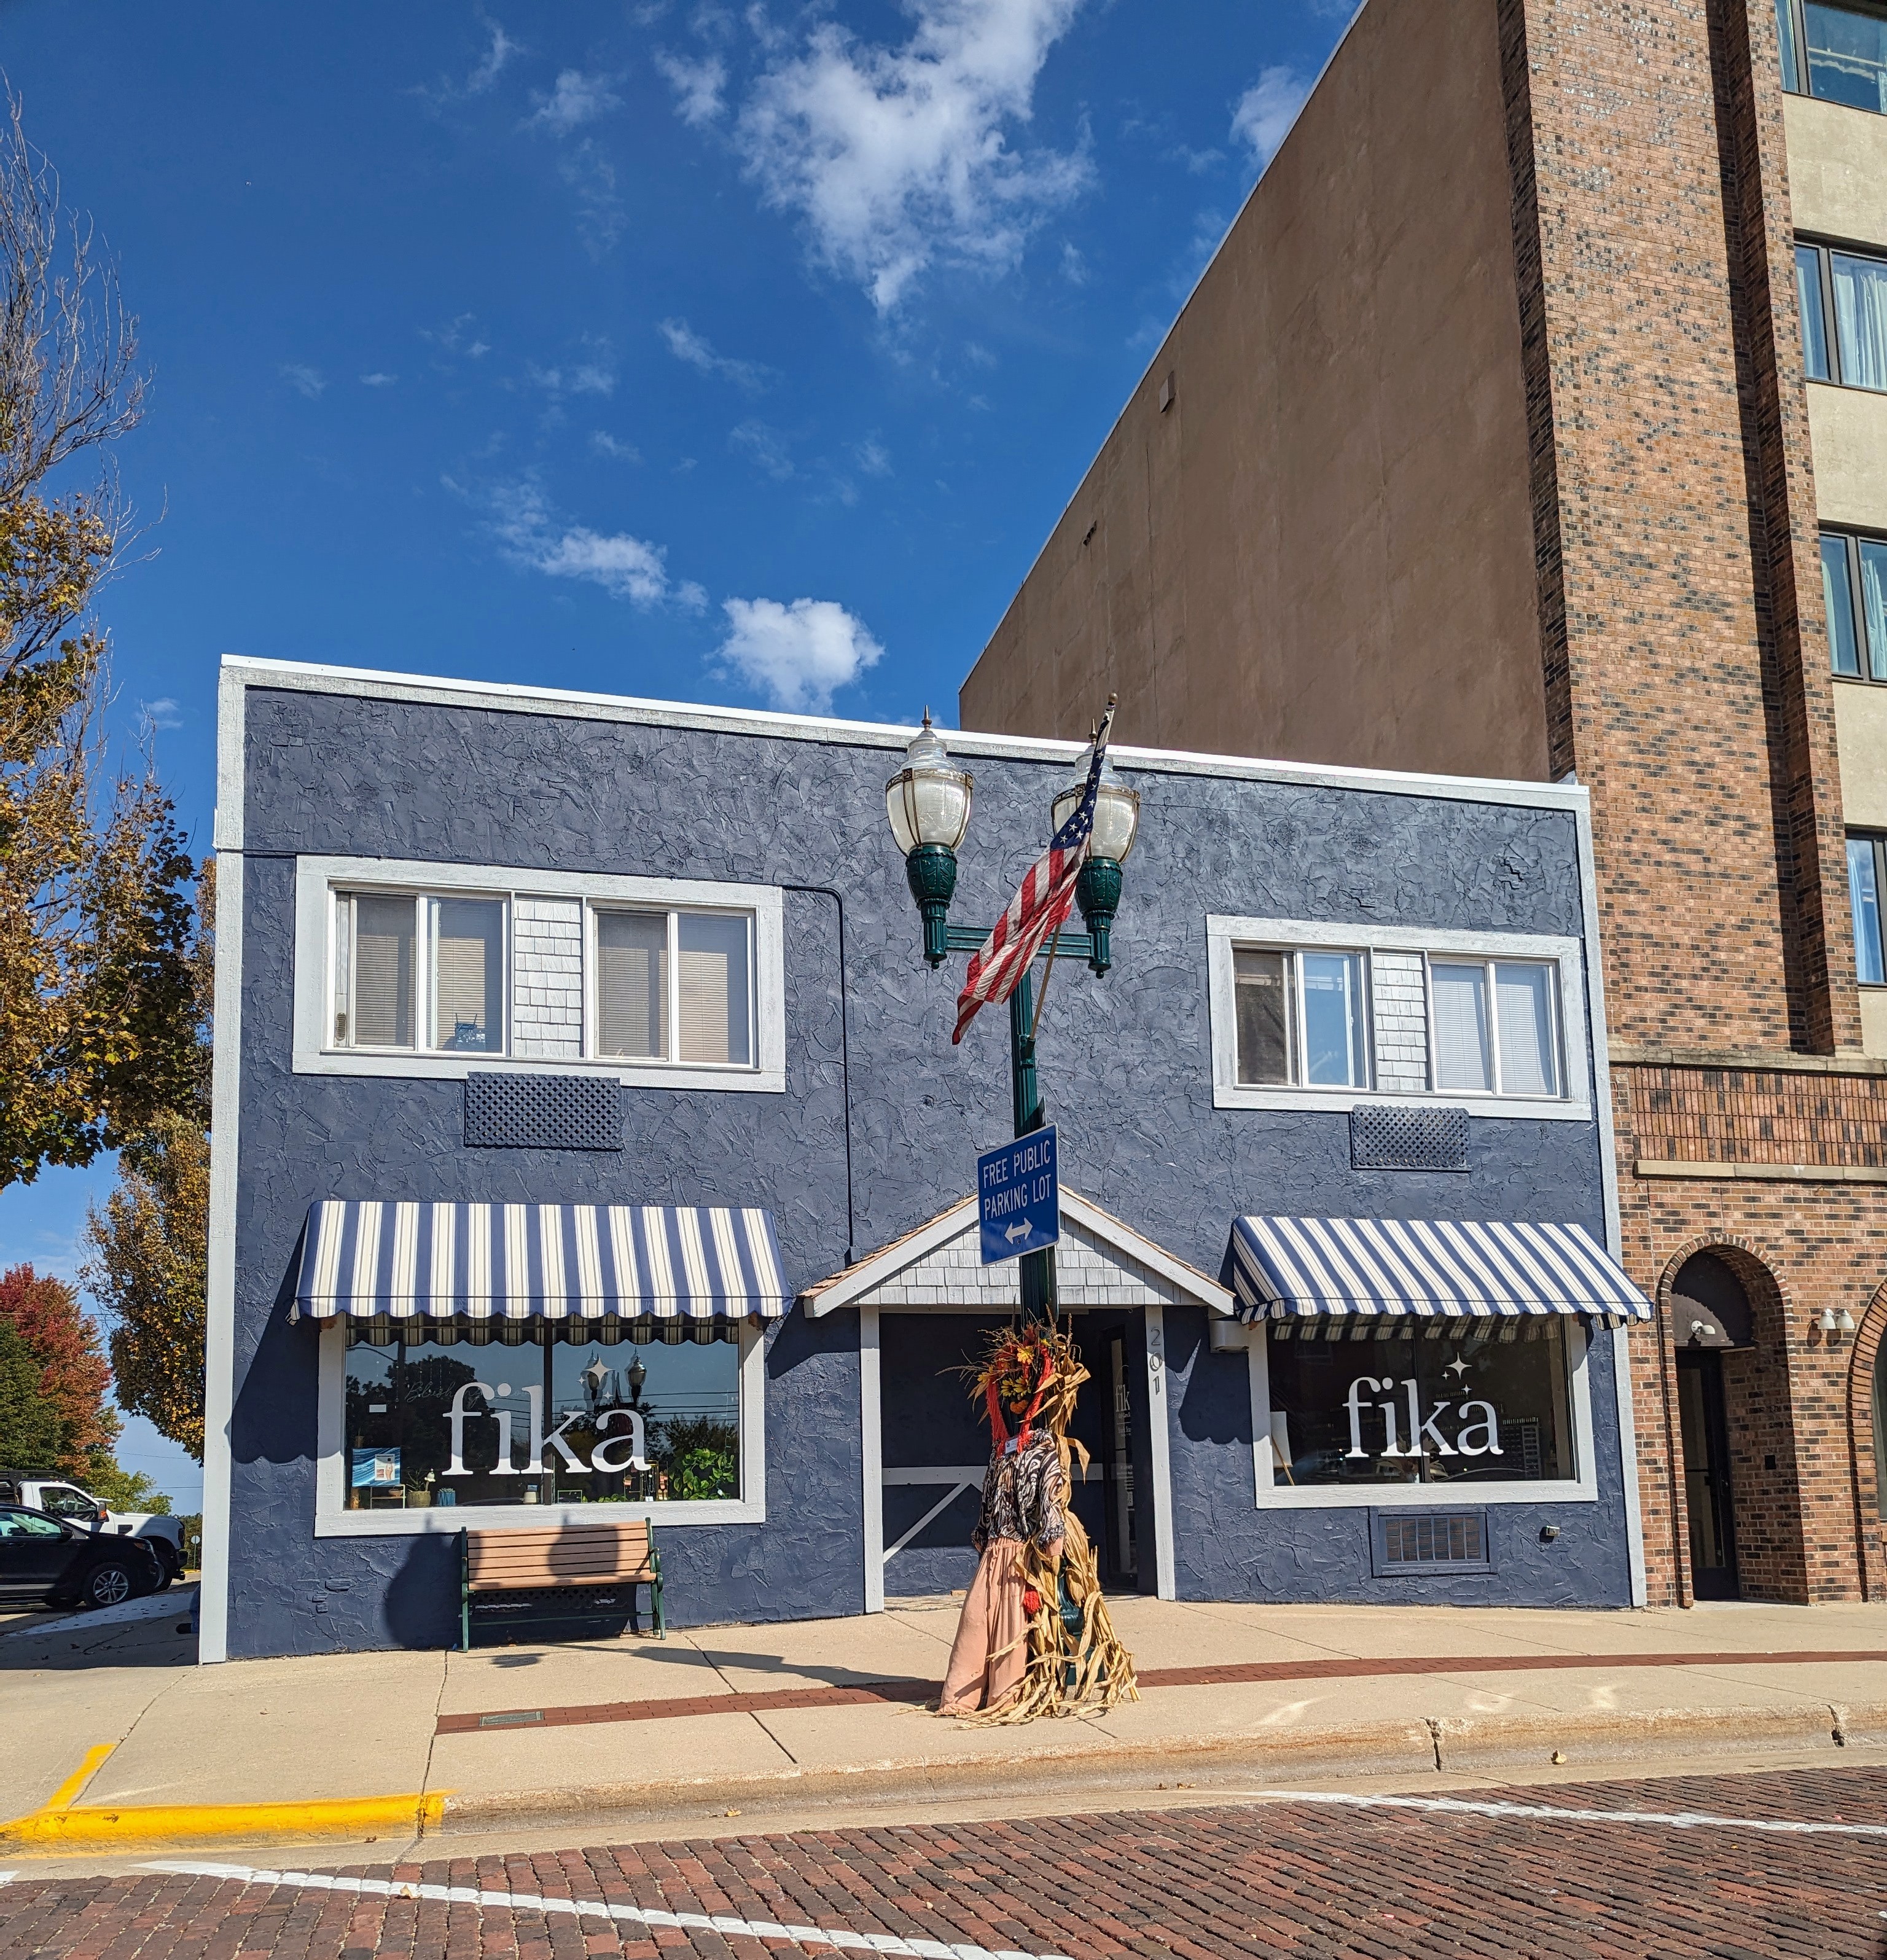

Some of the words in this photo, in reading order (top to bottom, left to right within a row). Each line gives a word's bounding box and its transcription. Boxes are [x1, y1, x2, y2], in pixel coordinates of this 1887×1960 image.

[983, 1157, 1008, 1189] FREE
[1014, 1139, 1051, 1177] PUBLIC
[984, 1183, 1028, 1221] PARKING
[1033, 1173, 1051, 1203] LOT
[1149, 1327, 1163, 1396] 201
[1115, 1384, 1130, 1412] fik
[1343, 1377, 1504, 1458] fika
[442, 1382, 652, 1475] fika
